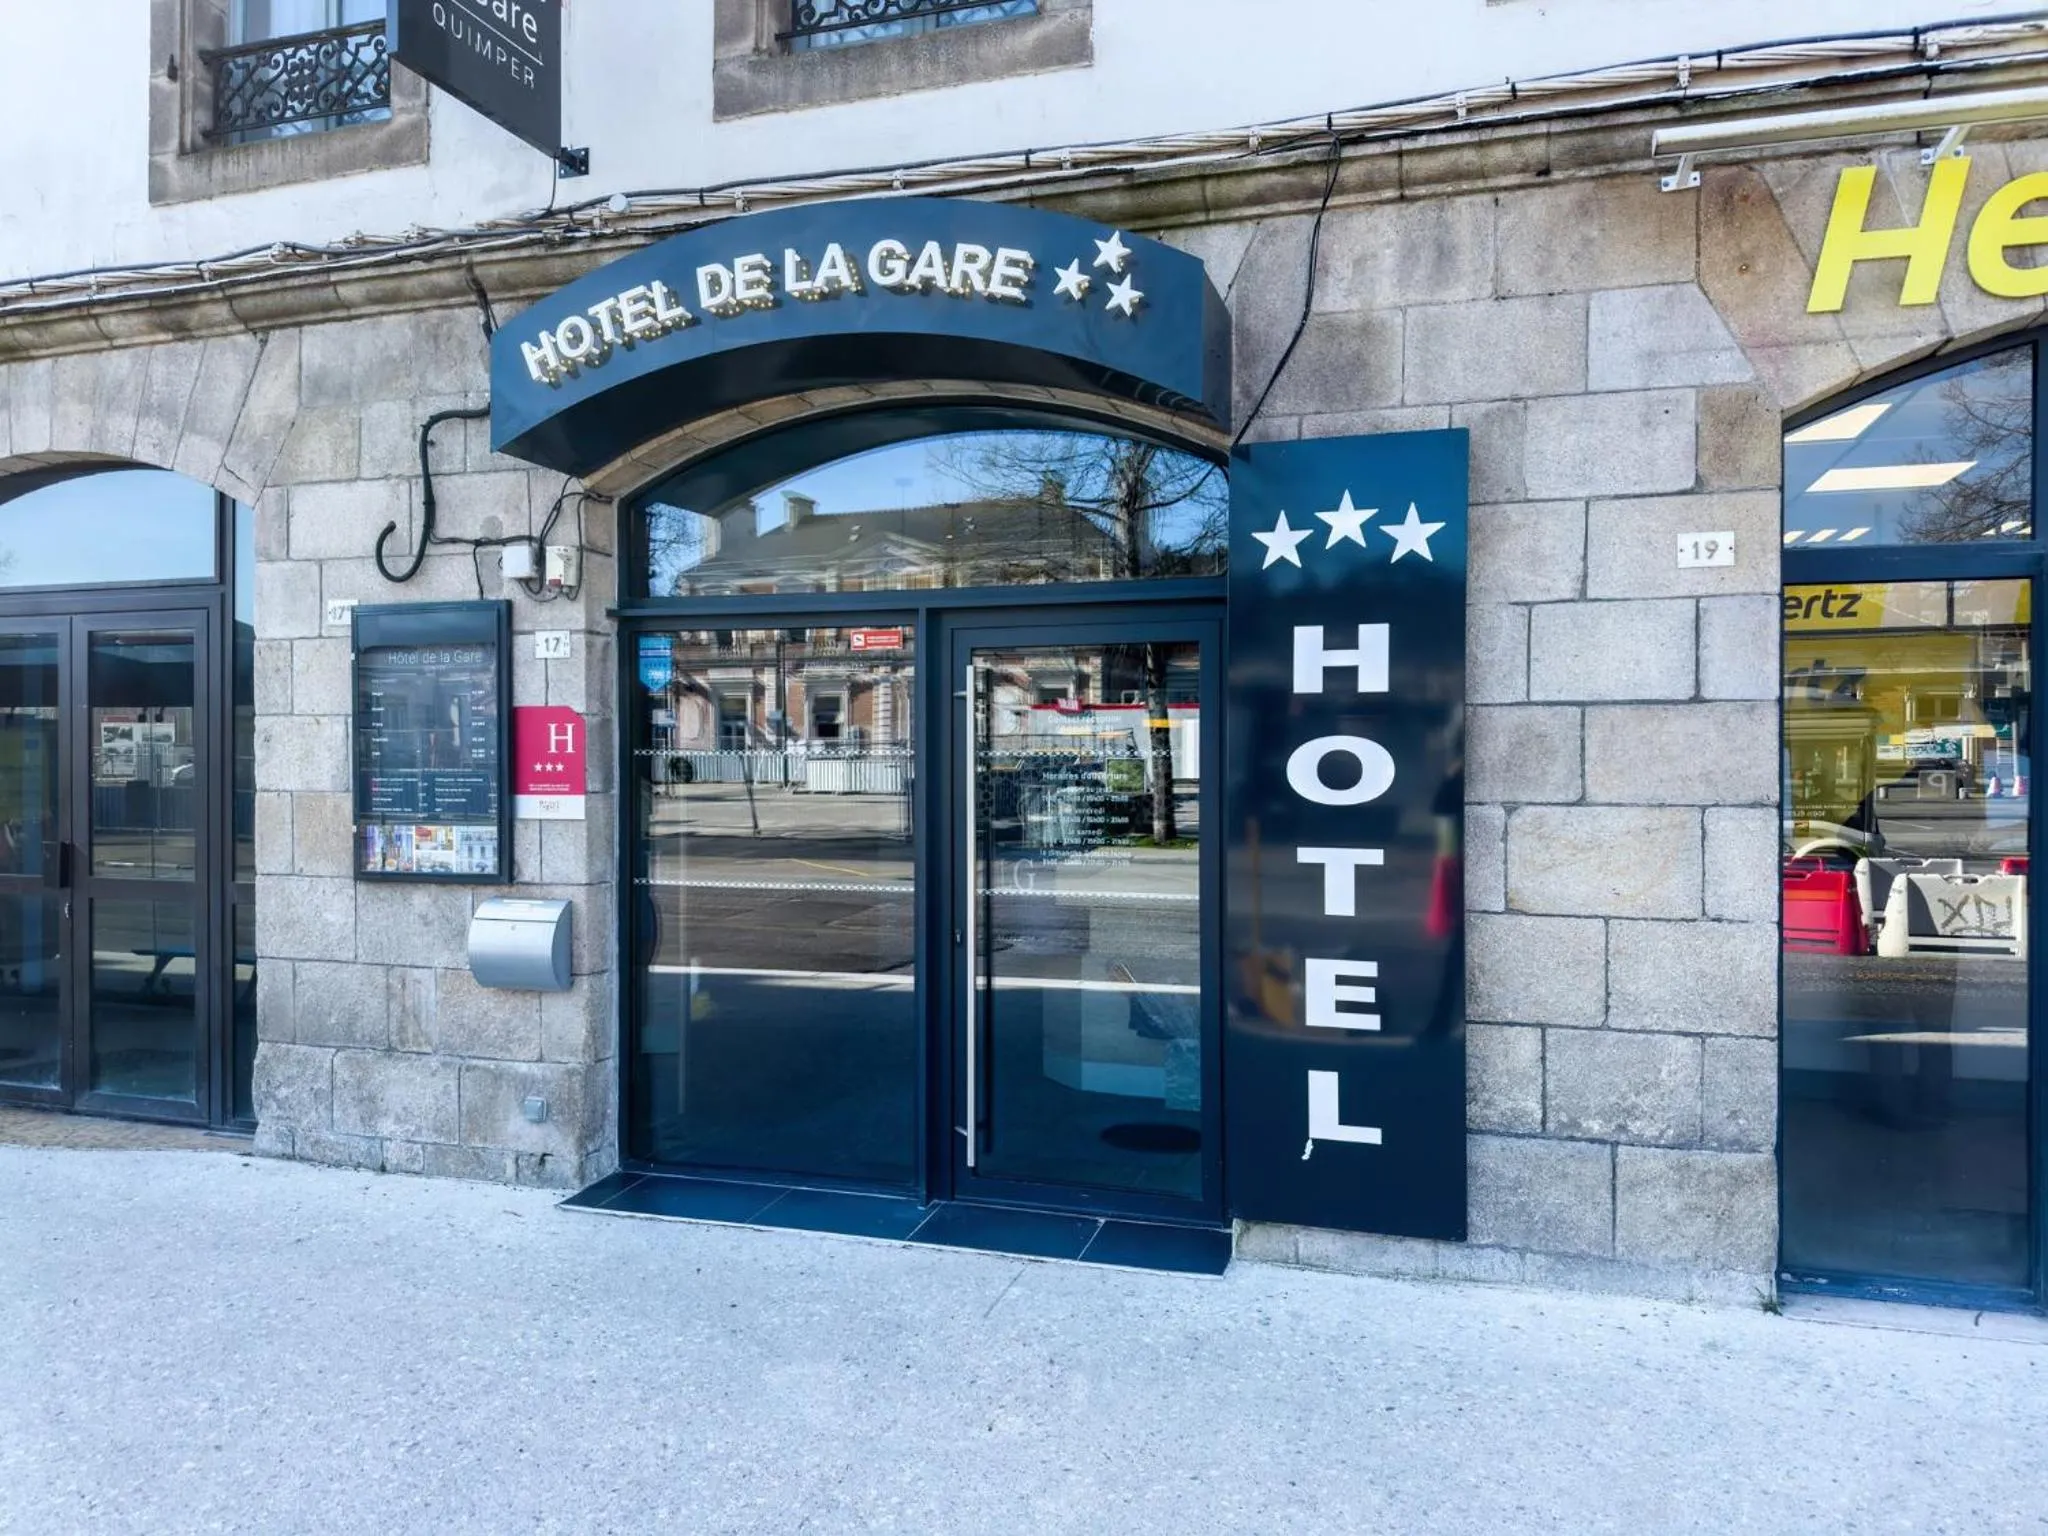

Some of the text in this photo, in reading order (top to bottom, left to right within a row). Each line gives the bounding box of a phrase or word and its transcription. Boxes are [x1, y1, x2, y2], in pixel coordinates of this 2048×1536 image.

[433, 3, 534, 89] QUIMPER
[1807, 157, 2048, 314] He
[520, 239, 1035, 382] HOTEL DE LA GARE
[1691, 540, 1720, 559] 19
[545, 637, 561, 652] 17
[548, 723, 575, 753] H
[1286, 623, 1396, 1145] HOTEL
